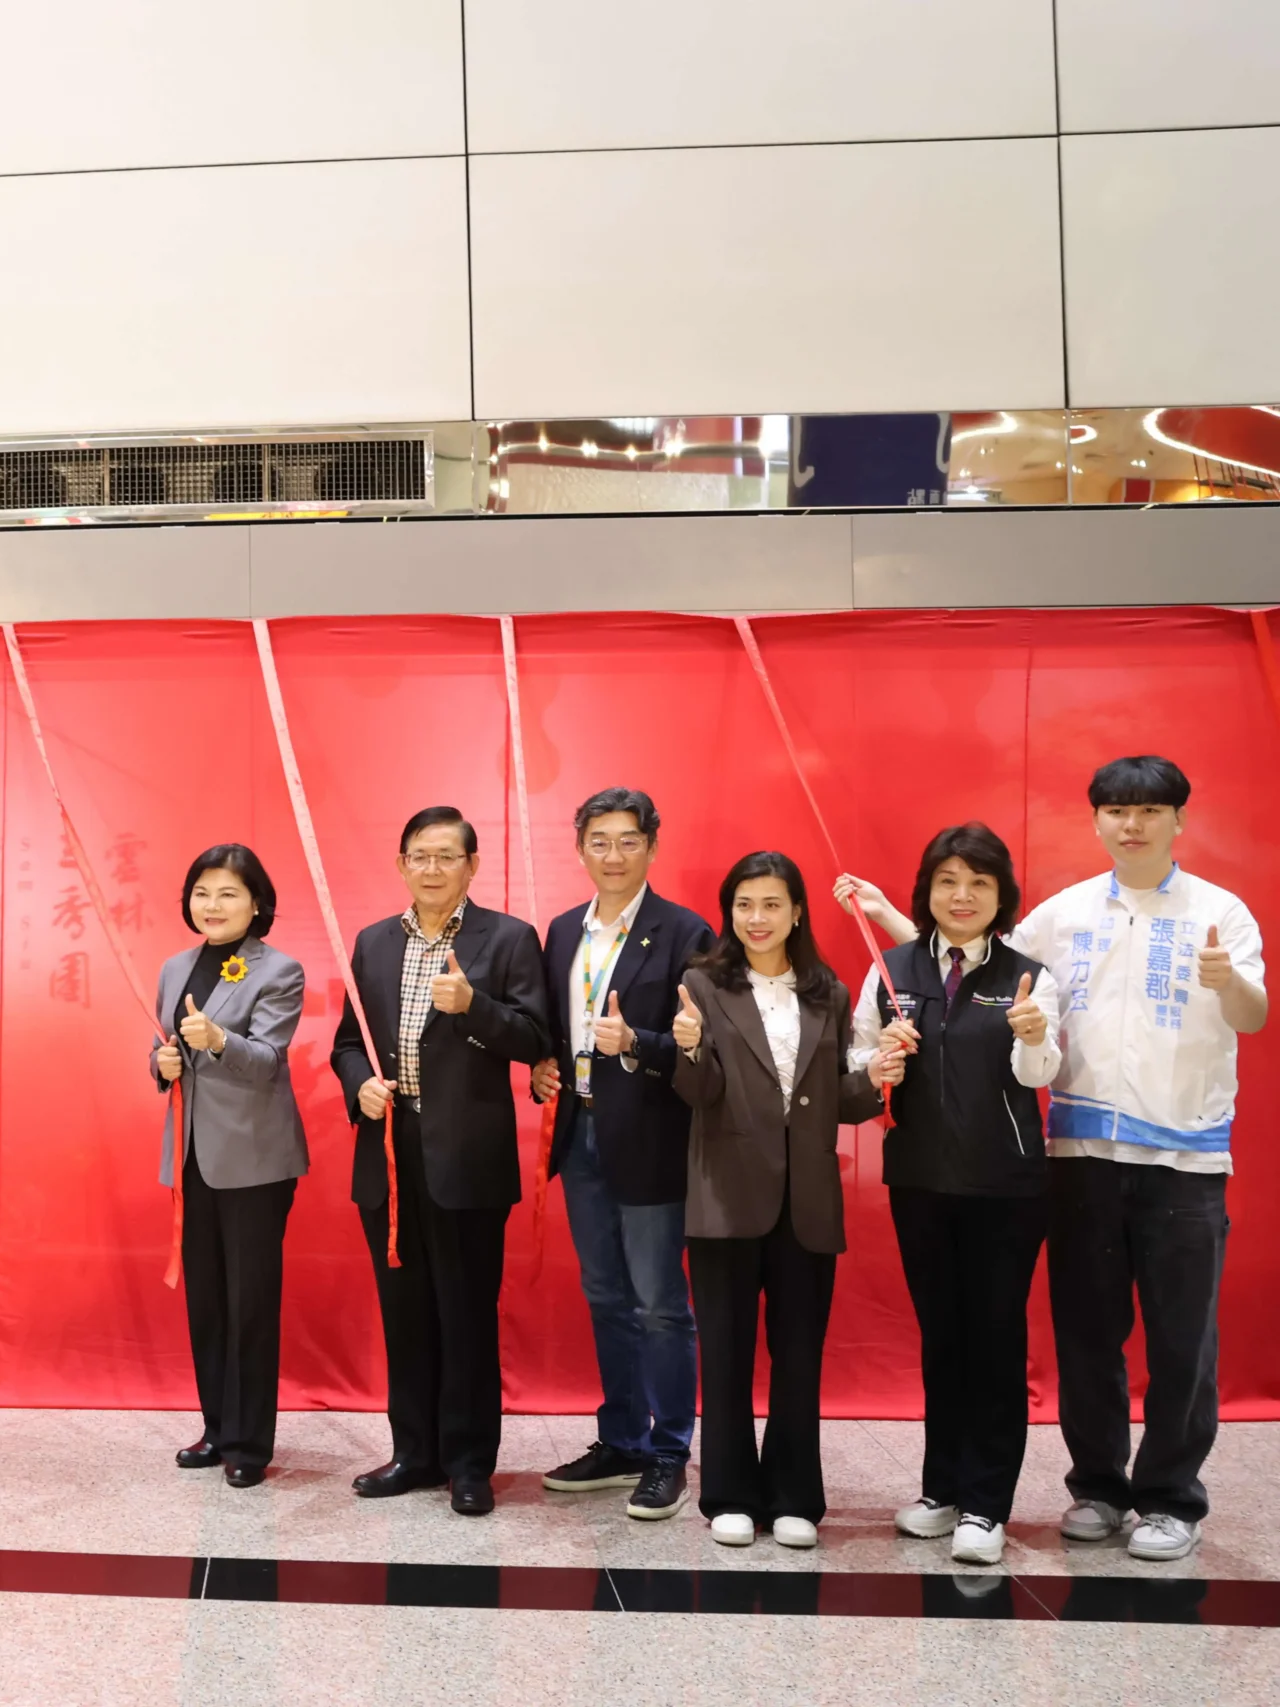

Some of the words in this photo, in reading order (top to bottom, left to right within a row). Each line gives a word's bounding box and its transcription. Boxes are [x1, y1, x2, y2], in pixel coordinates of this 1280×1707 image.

[1145, 917, 1176, 1000] 張嘉郡
[1173, 921, 1197, 1005] 立法委員
